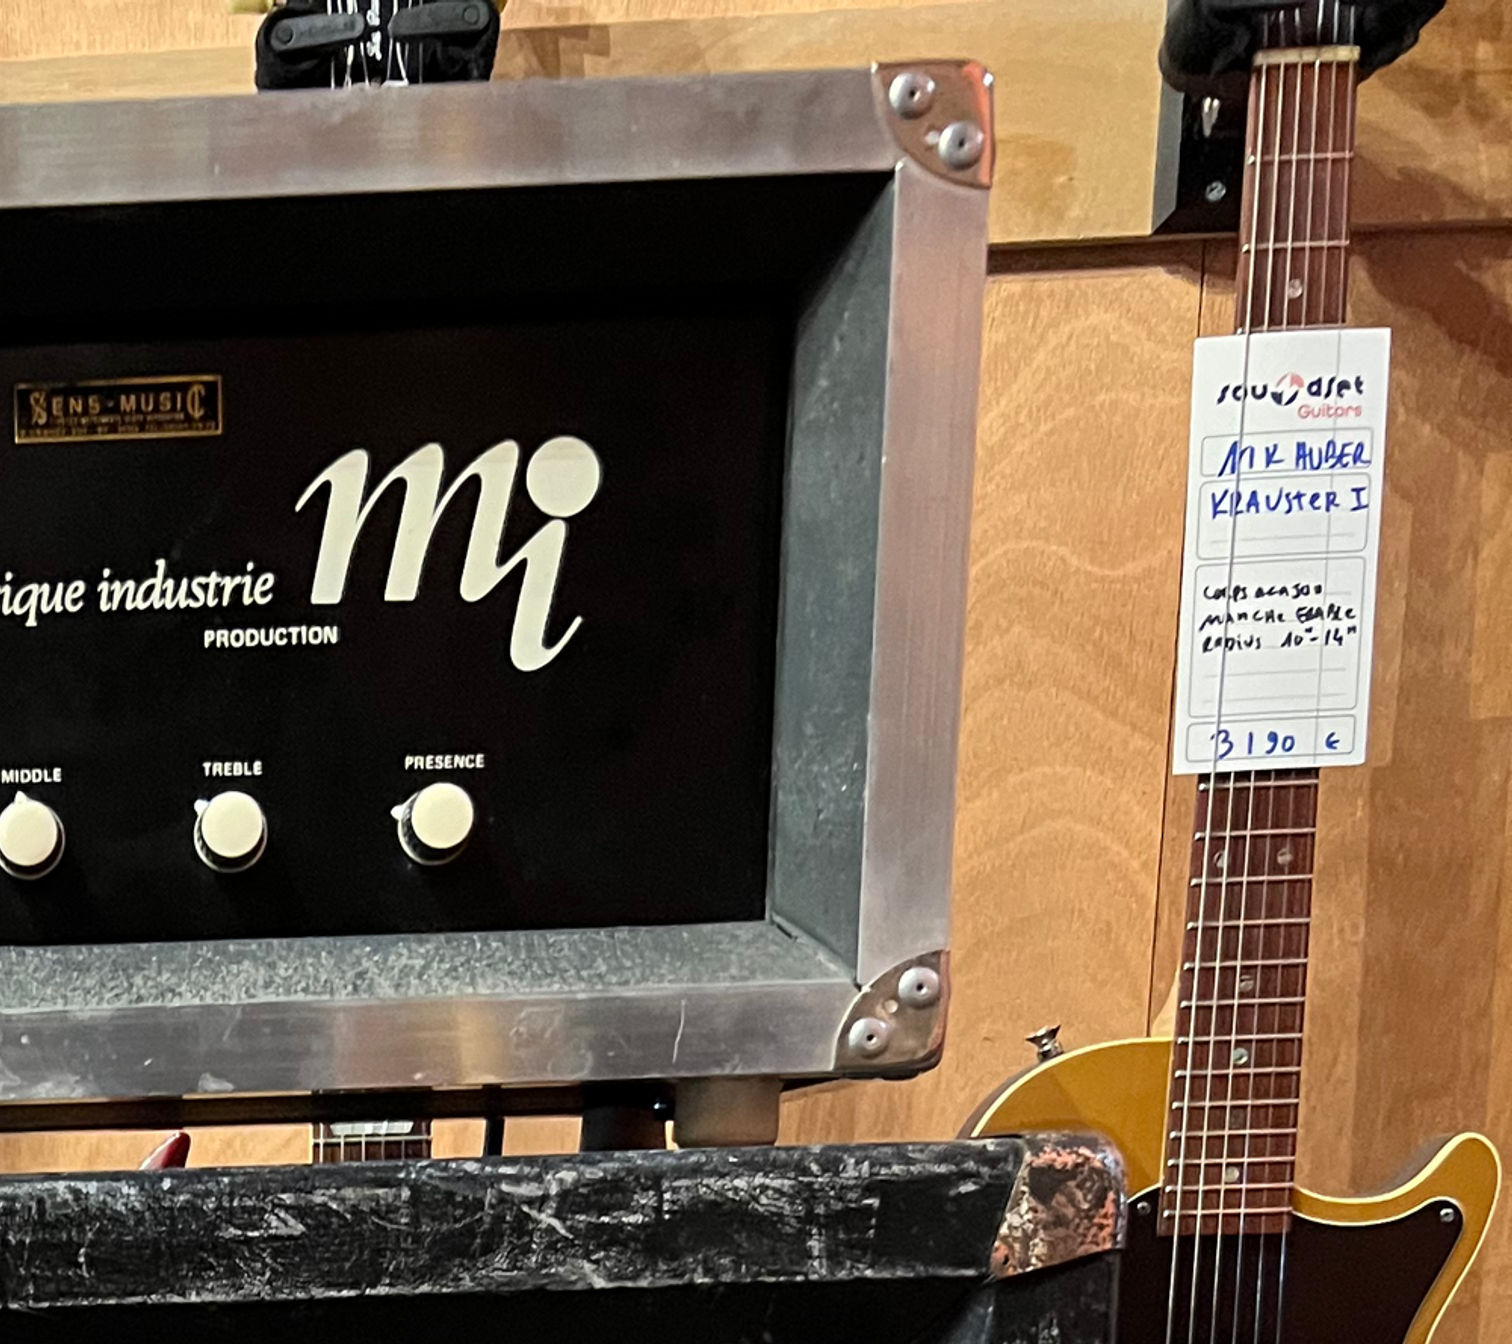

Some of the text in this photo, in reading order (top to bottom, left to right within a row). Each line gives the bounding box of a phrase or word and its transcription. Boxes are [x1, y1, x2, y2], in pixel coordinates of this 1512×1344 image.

[1297, 401, 1362, 420] Guitars
[97, 559, 275, 613] industrie
[203, 624, 339, 649] PRODUCTION
[202, 760, 263, 778] TREBLE
[404, 753, 486, 771] PRESENCE
[0, 767, 63, 784] MIDDLE
